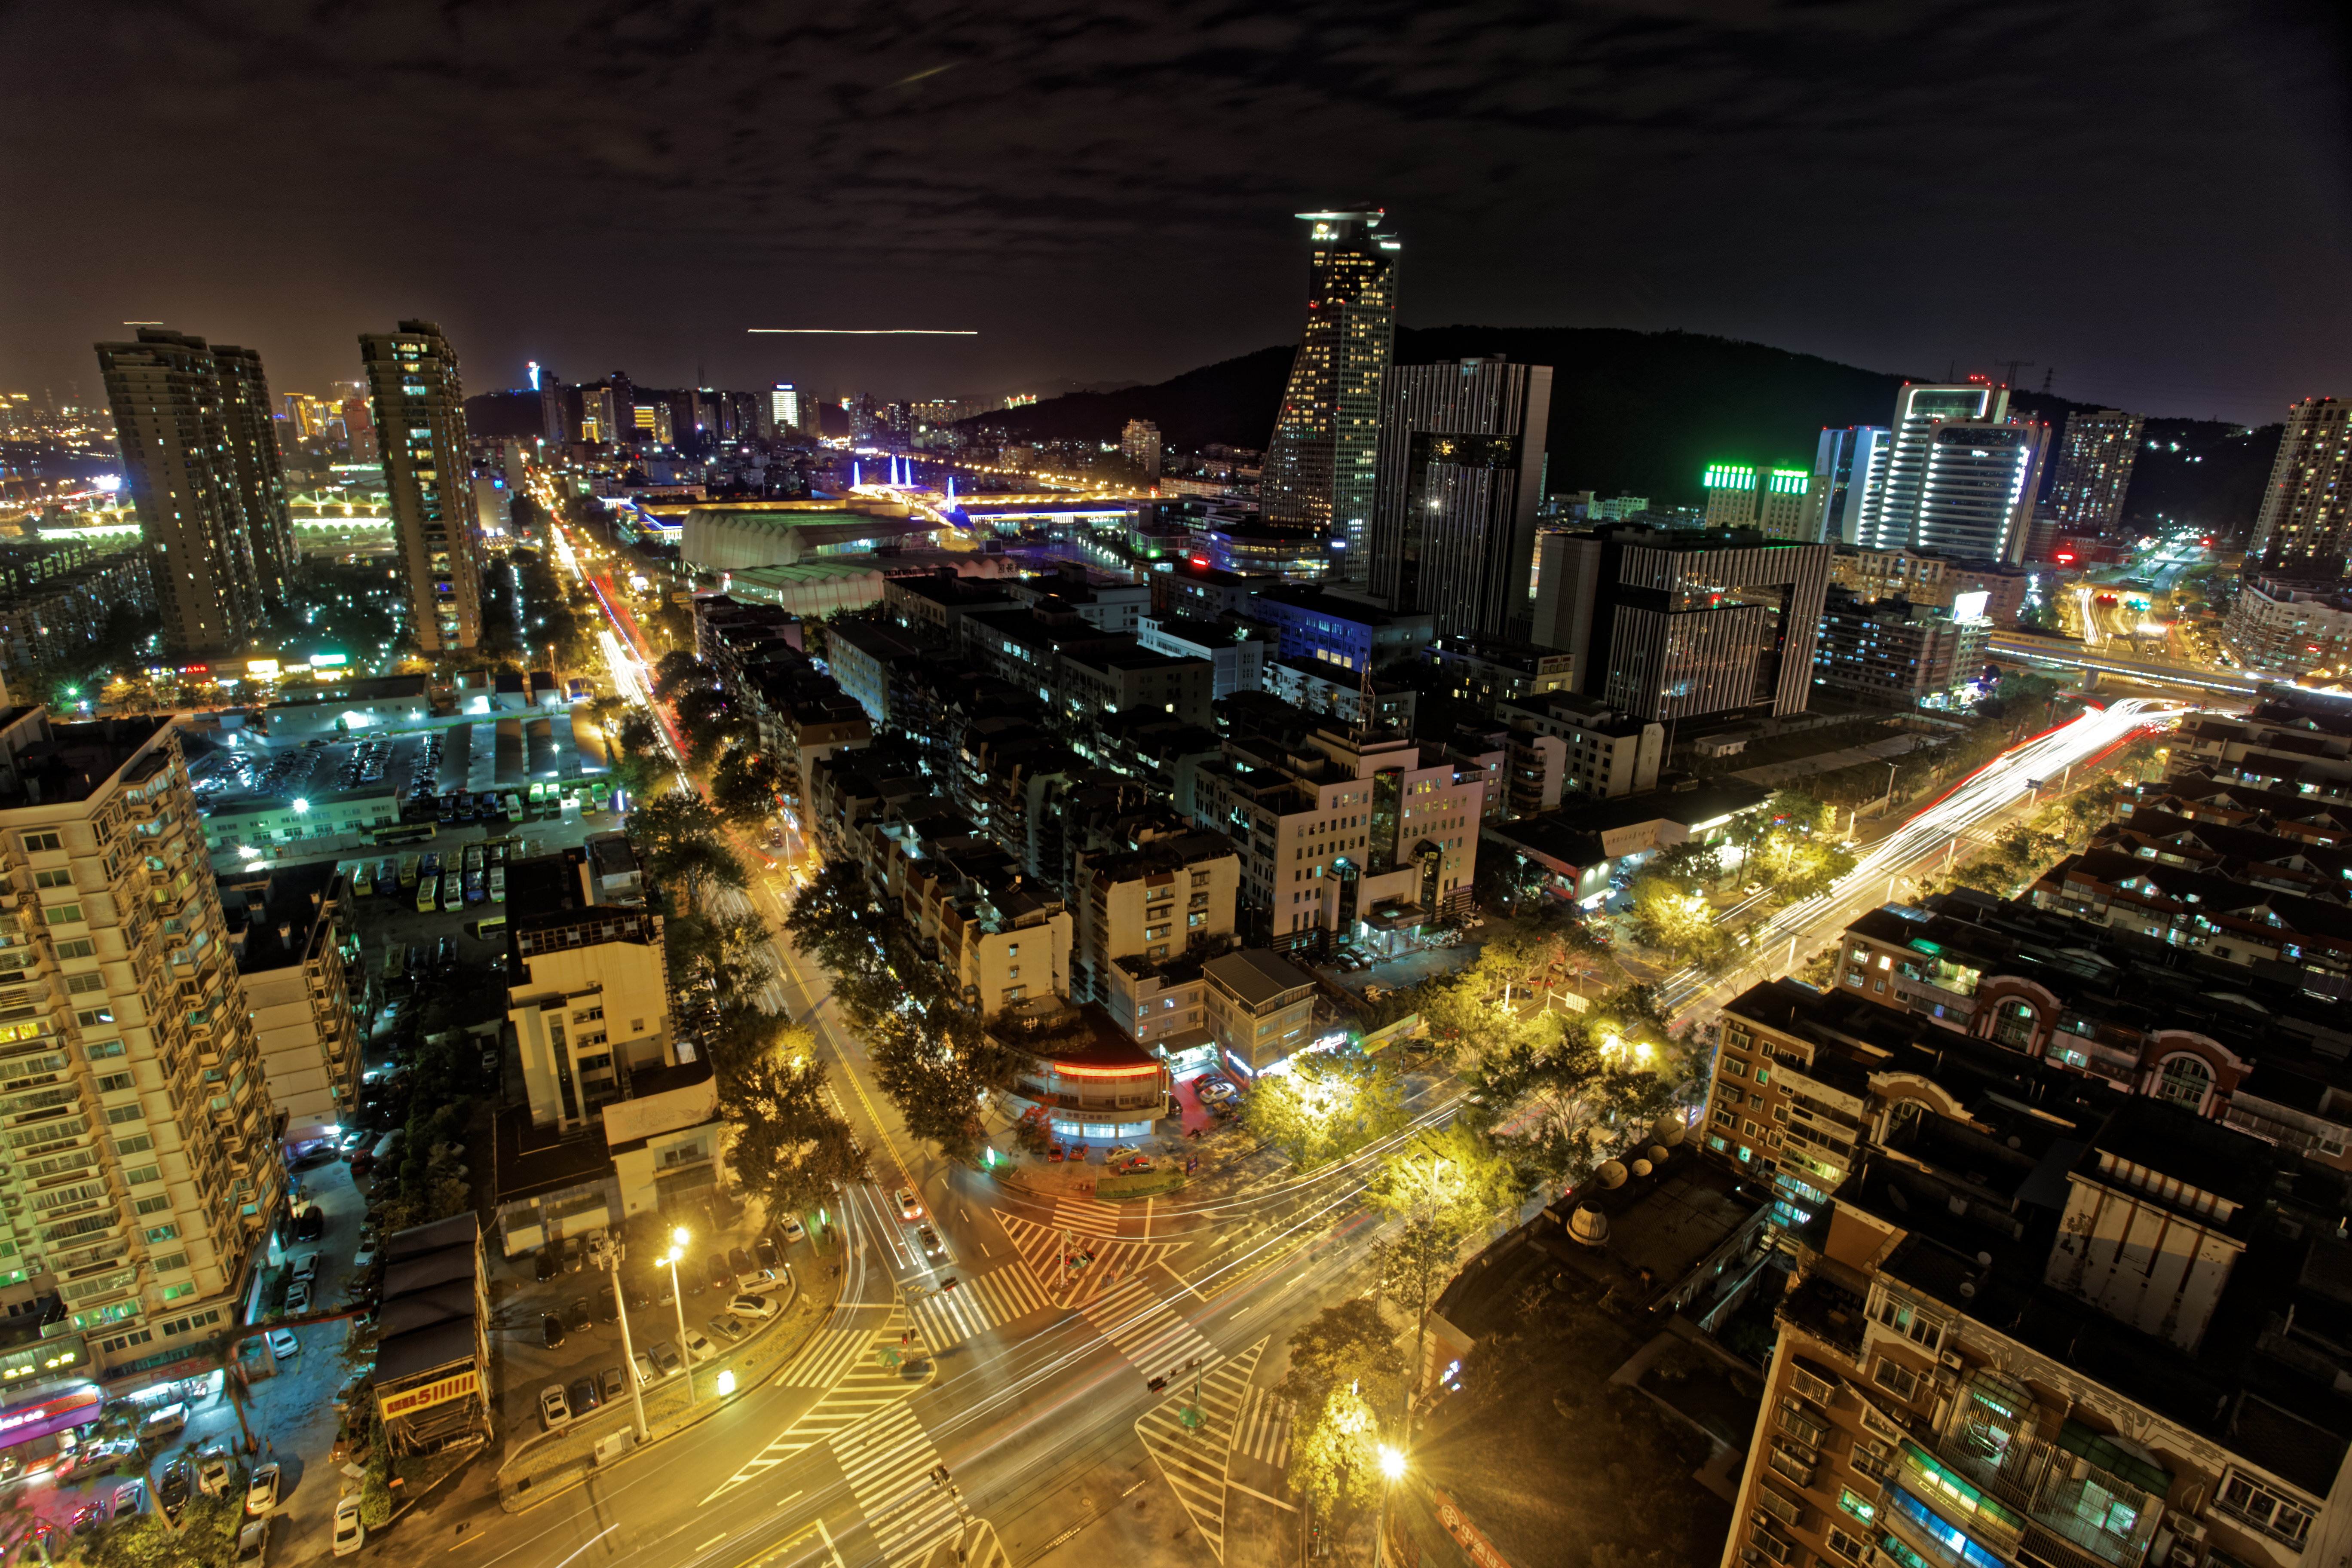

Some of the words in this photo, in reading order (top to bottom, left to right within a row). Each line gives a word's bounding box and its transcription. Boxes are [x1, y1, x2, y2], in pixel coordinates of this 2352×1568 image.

[1066, 1112, 1111, 1121] 中国工商银行
